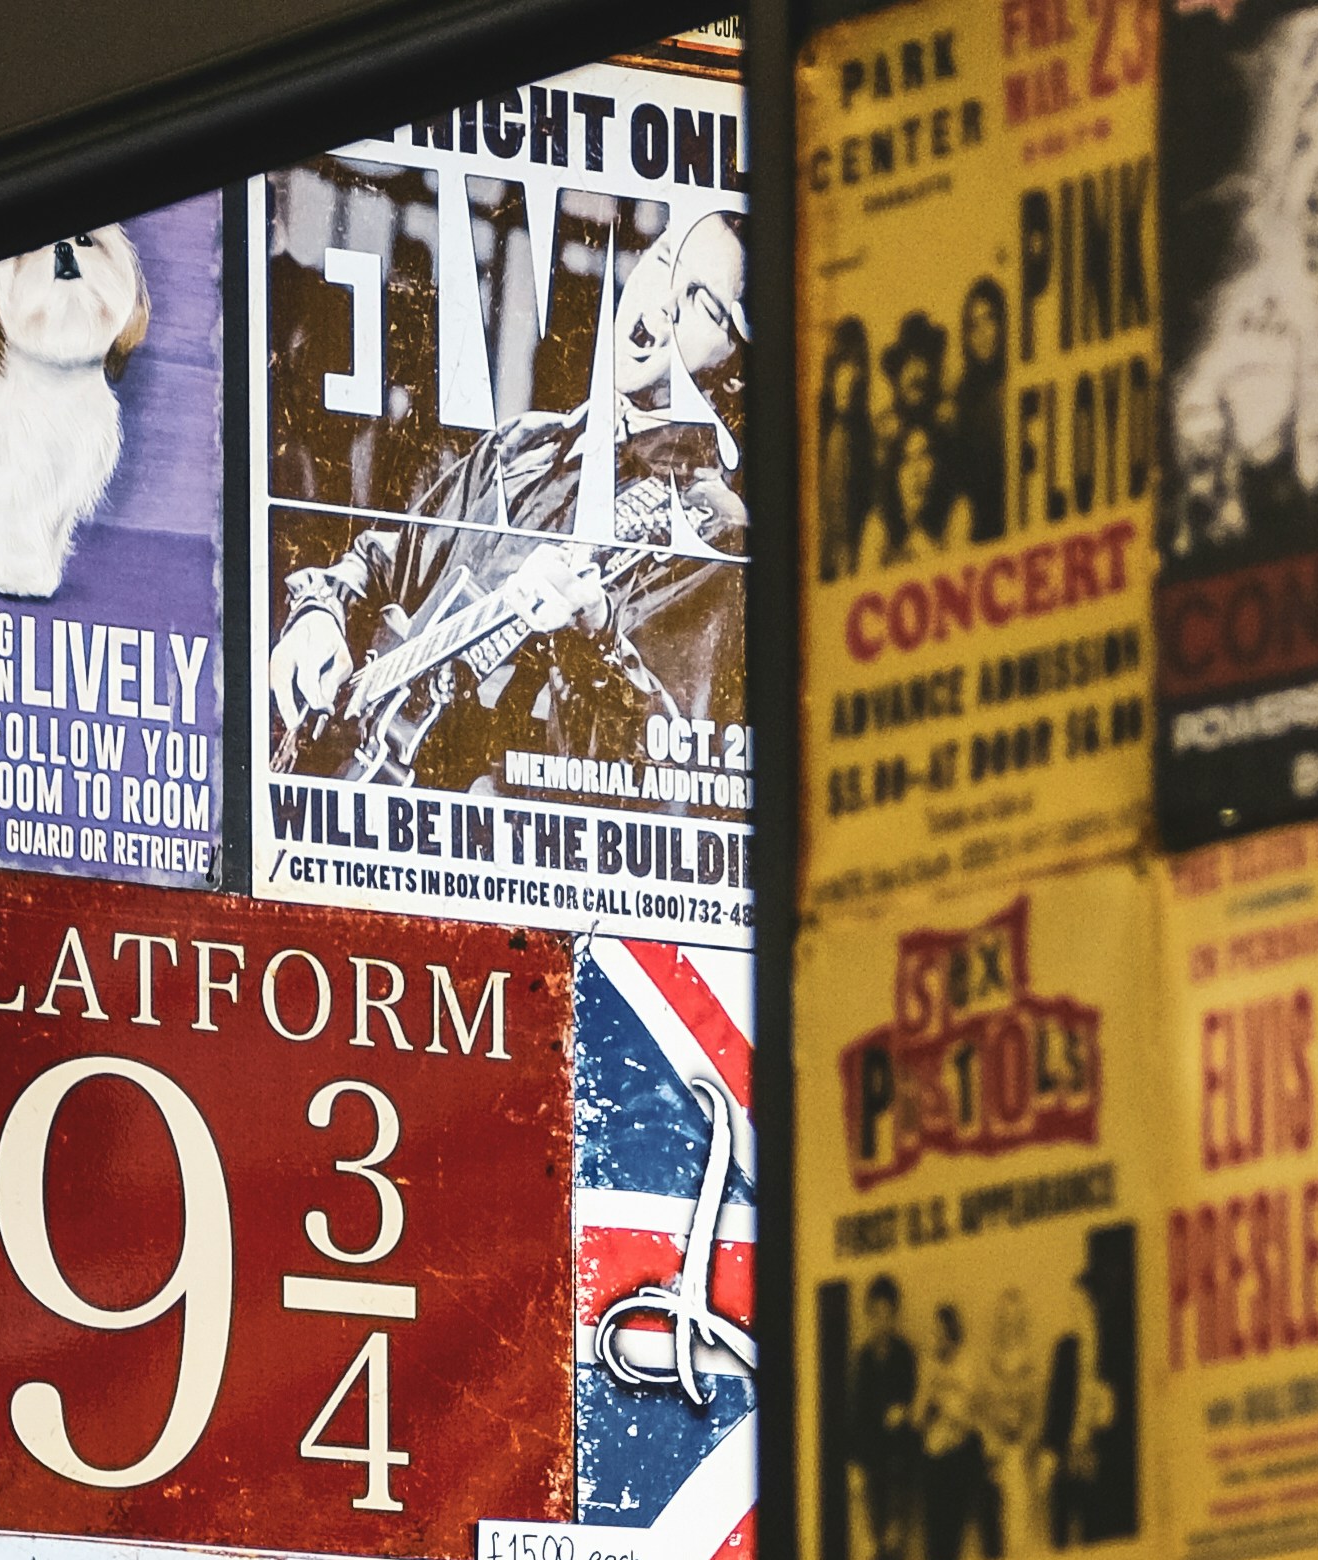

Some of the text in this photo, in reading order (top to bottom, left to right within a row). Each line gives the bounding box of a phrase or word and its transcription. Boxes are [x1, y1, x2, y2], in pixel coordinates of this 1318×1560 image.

[845, 522, 1137, 662] CONCERT
[20, 615, 209, 724] LIVELY
[142, 728, 208, 781] YOU
[506, 750, 638, 798] MEMORIAL
[647, 714, 719, 766] OCT.
[74, 770, 110, 820] TO
[123, 778, 210, 831] ROOM
[270, 783, 588, 871] WILL BE IN THE
[6, 819, 74, 860] GUARD
[80, 828, 107, 865] OR
[112, 832, 210, 874] RETRIEVE
[290, 856, 548, 907] GET TICKETS IN BOX OFFICE
[898, 945, 1011, 1034] SEX
[859, 1023, 1097, 1167] PISTOLS
[1201, 987, 1316, 1171] ELVIS
[303, 1079, 406, 1265] 3
[299, 1331, 411, 1513] 4
